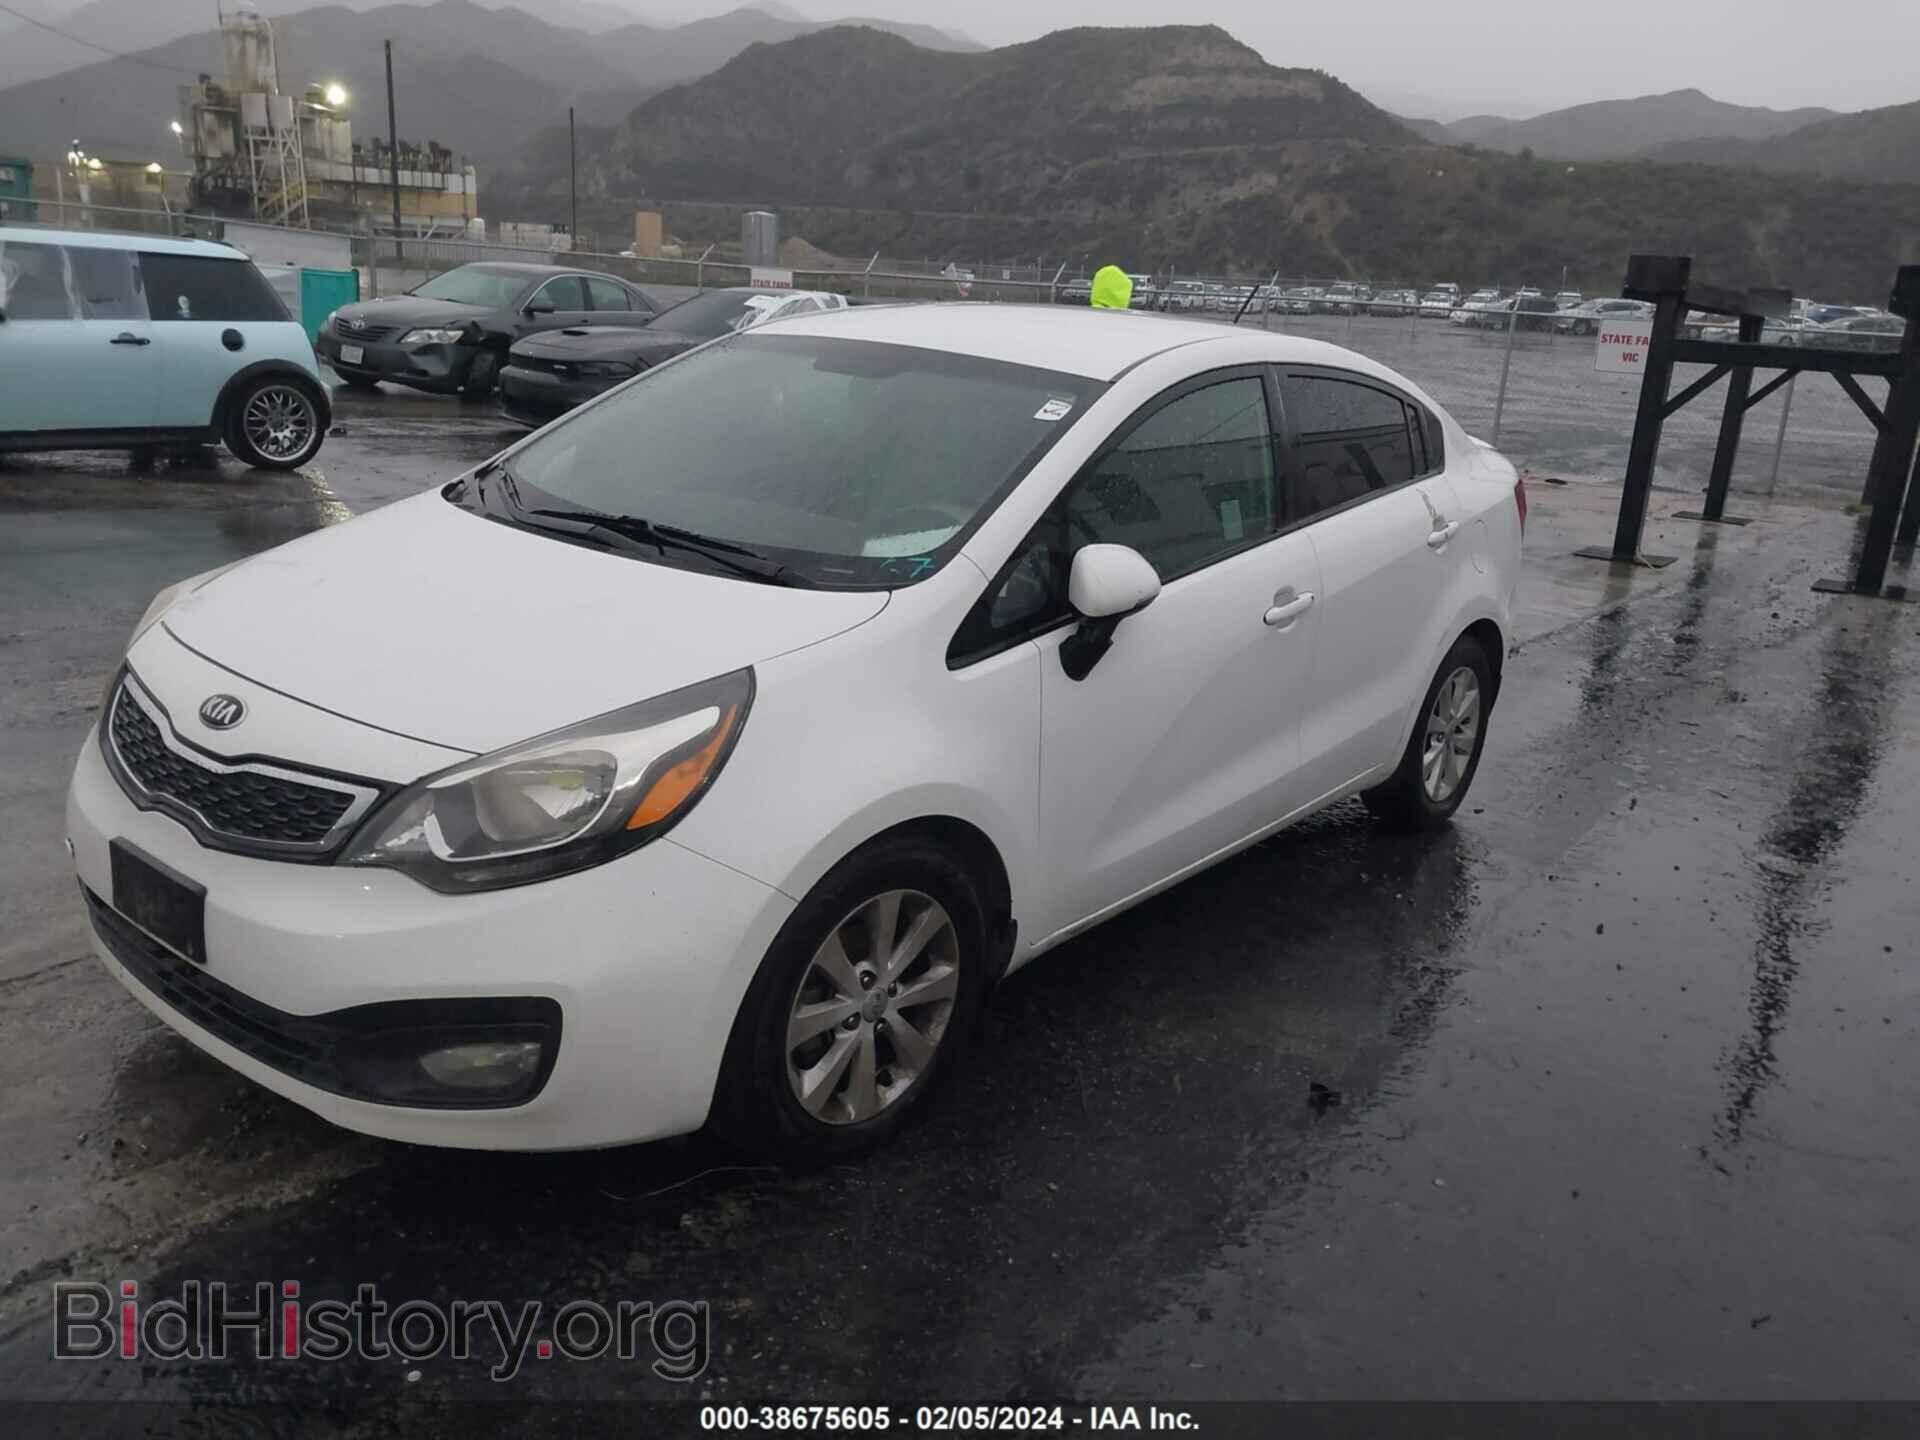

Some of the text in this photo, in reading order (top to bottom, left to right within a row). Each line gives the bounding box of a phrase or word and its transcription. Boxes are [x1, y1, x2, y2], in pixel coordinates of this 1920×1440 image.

[1600, 334, 1649, 346] STATE FA
[1622, 352, 1639, 362] VIC
[201, 698, 238, 725] KIA
